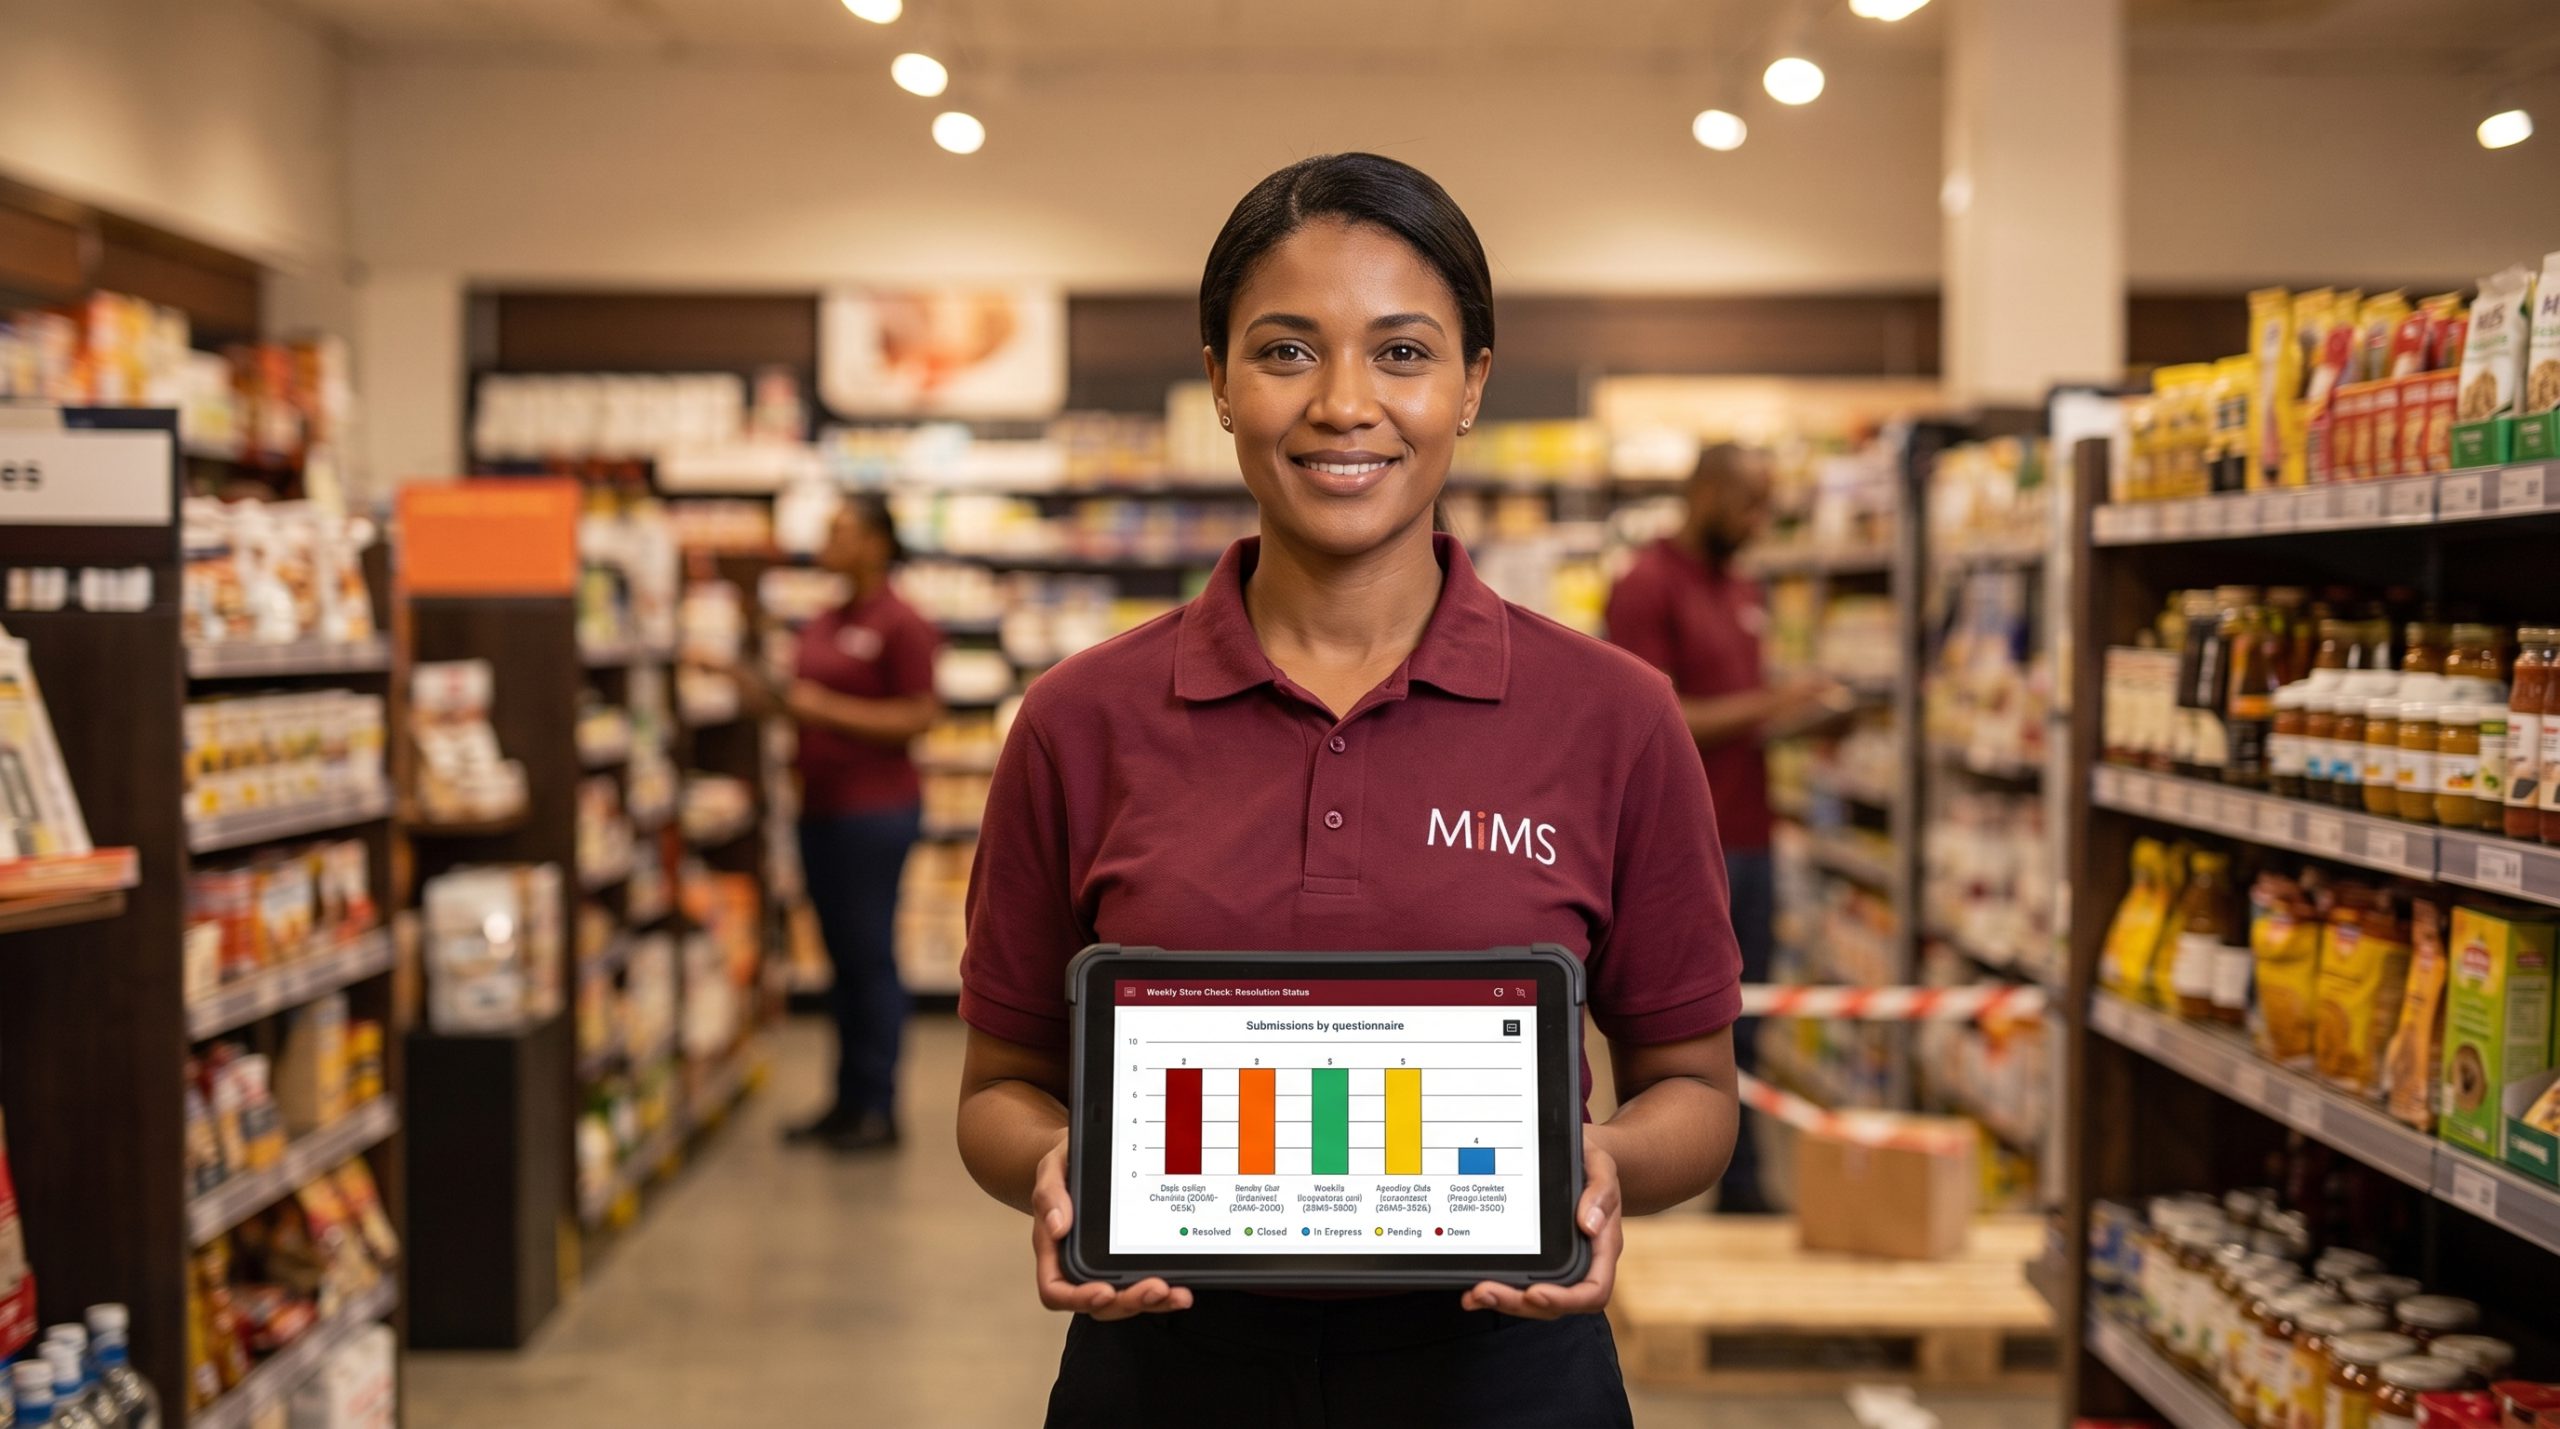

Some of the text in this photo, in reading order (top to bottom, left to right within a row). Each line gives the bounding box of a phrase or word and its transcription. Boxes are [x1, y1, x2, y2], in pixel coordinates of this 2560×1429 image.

[1427, 808, 1556, 865] MiMS
[1147, 988, 1309, 998] Weekly Store Check: Resolution Status
[1246, 1020, 1404, 1033] Submissions by questionnaire
[1128, 1038, 1138, 1046] 10
[1132, 1064, 1138, 1073] 8
[1132, 1091, 1138, 1099] 6
[1132, 1117, 1138, 1125] 4
[1132, 1143, 1138, 1152] 2
[1131, 1170, 1138, 1179] 0
[1192, 1227, 1231, 1237] Resolved
[1257, 1227, 1287, 1237] Closed
[1313, 1227, 1322, 1237] In
[1387, 1227, 1422, 1239] Pending
